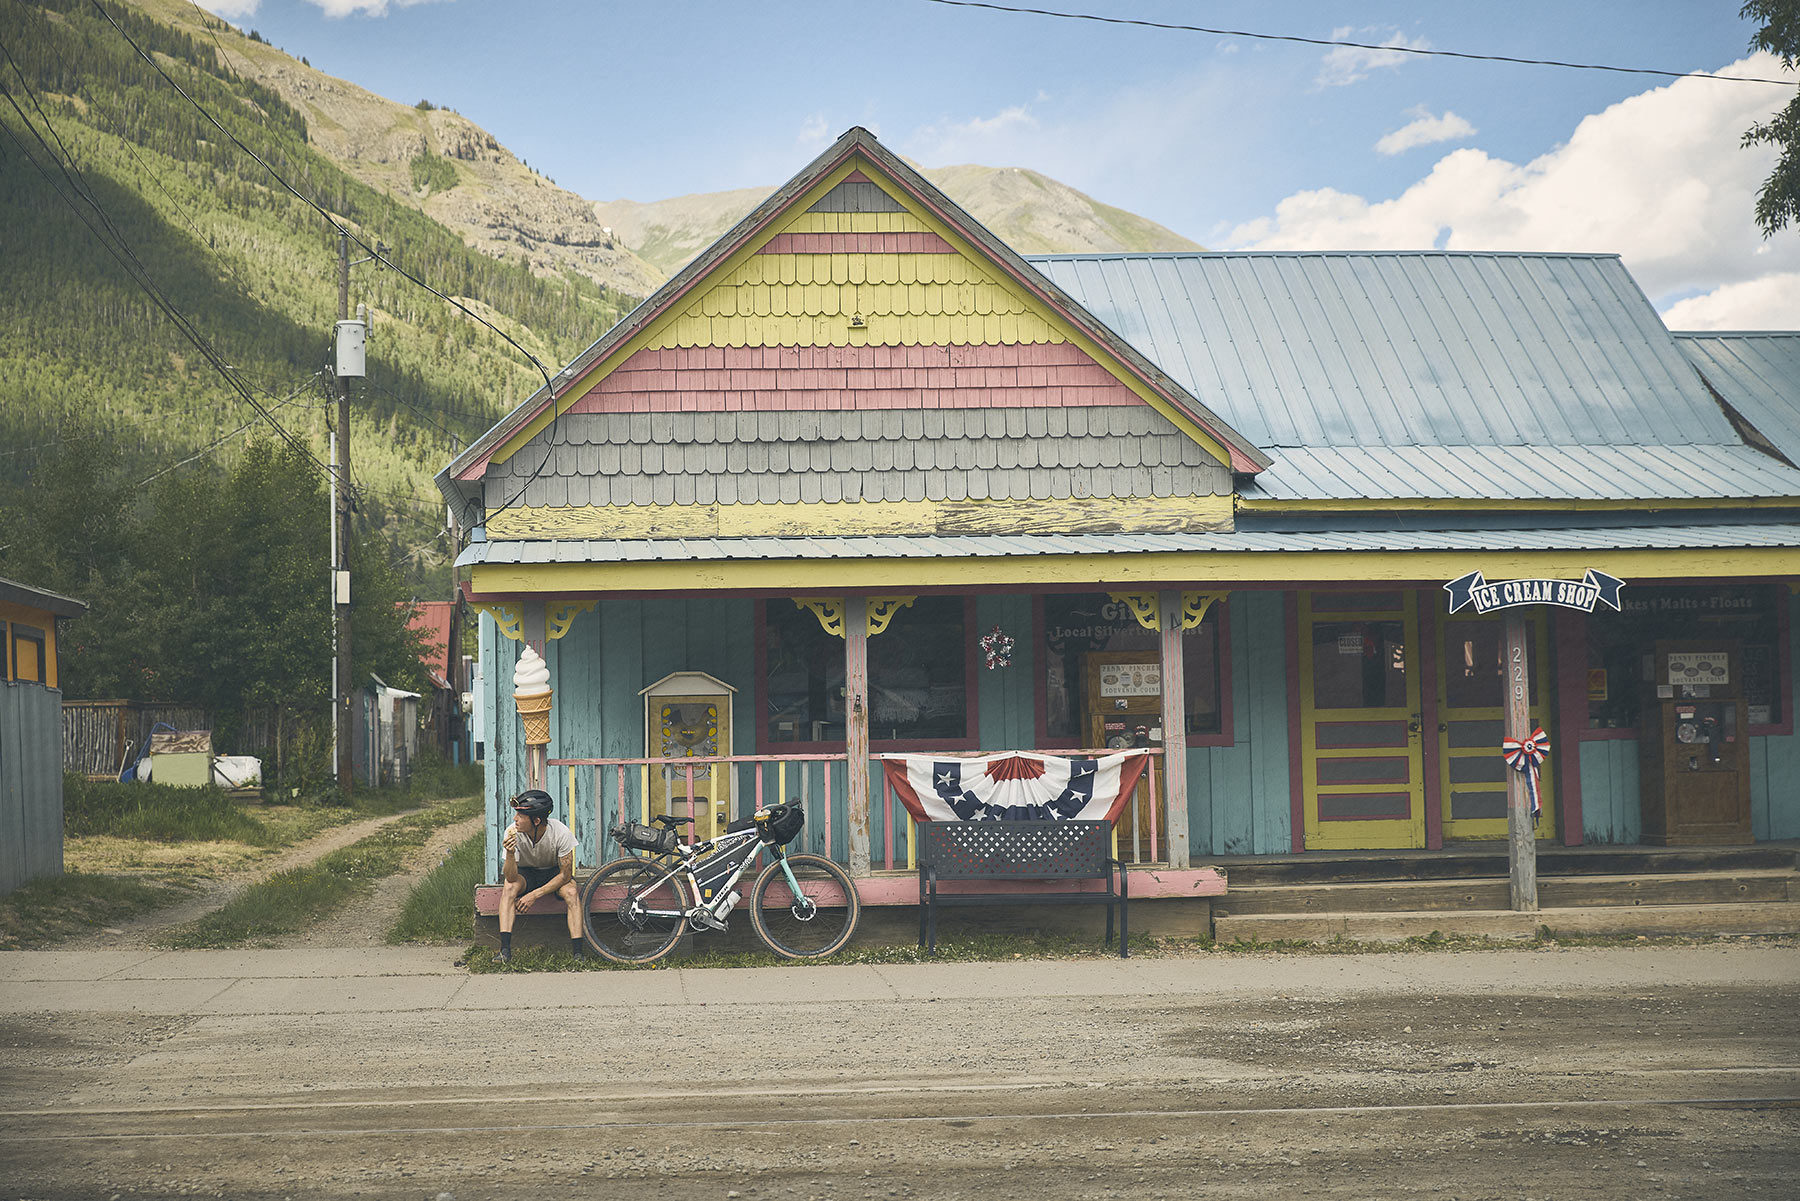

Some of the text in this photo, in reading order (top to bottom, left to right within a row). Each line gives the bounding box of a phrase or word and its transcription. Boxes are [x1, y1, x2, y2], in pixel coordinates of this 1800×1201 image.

[1474, 581, 1595, 610] ICE CREAM SHOP
[1660, 598, 1698, 610] Malts
[1710, 597, 1753, 609] Floats
[1056, 626, 1091, 638] Local
